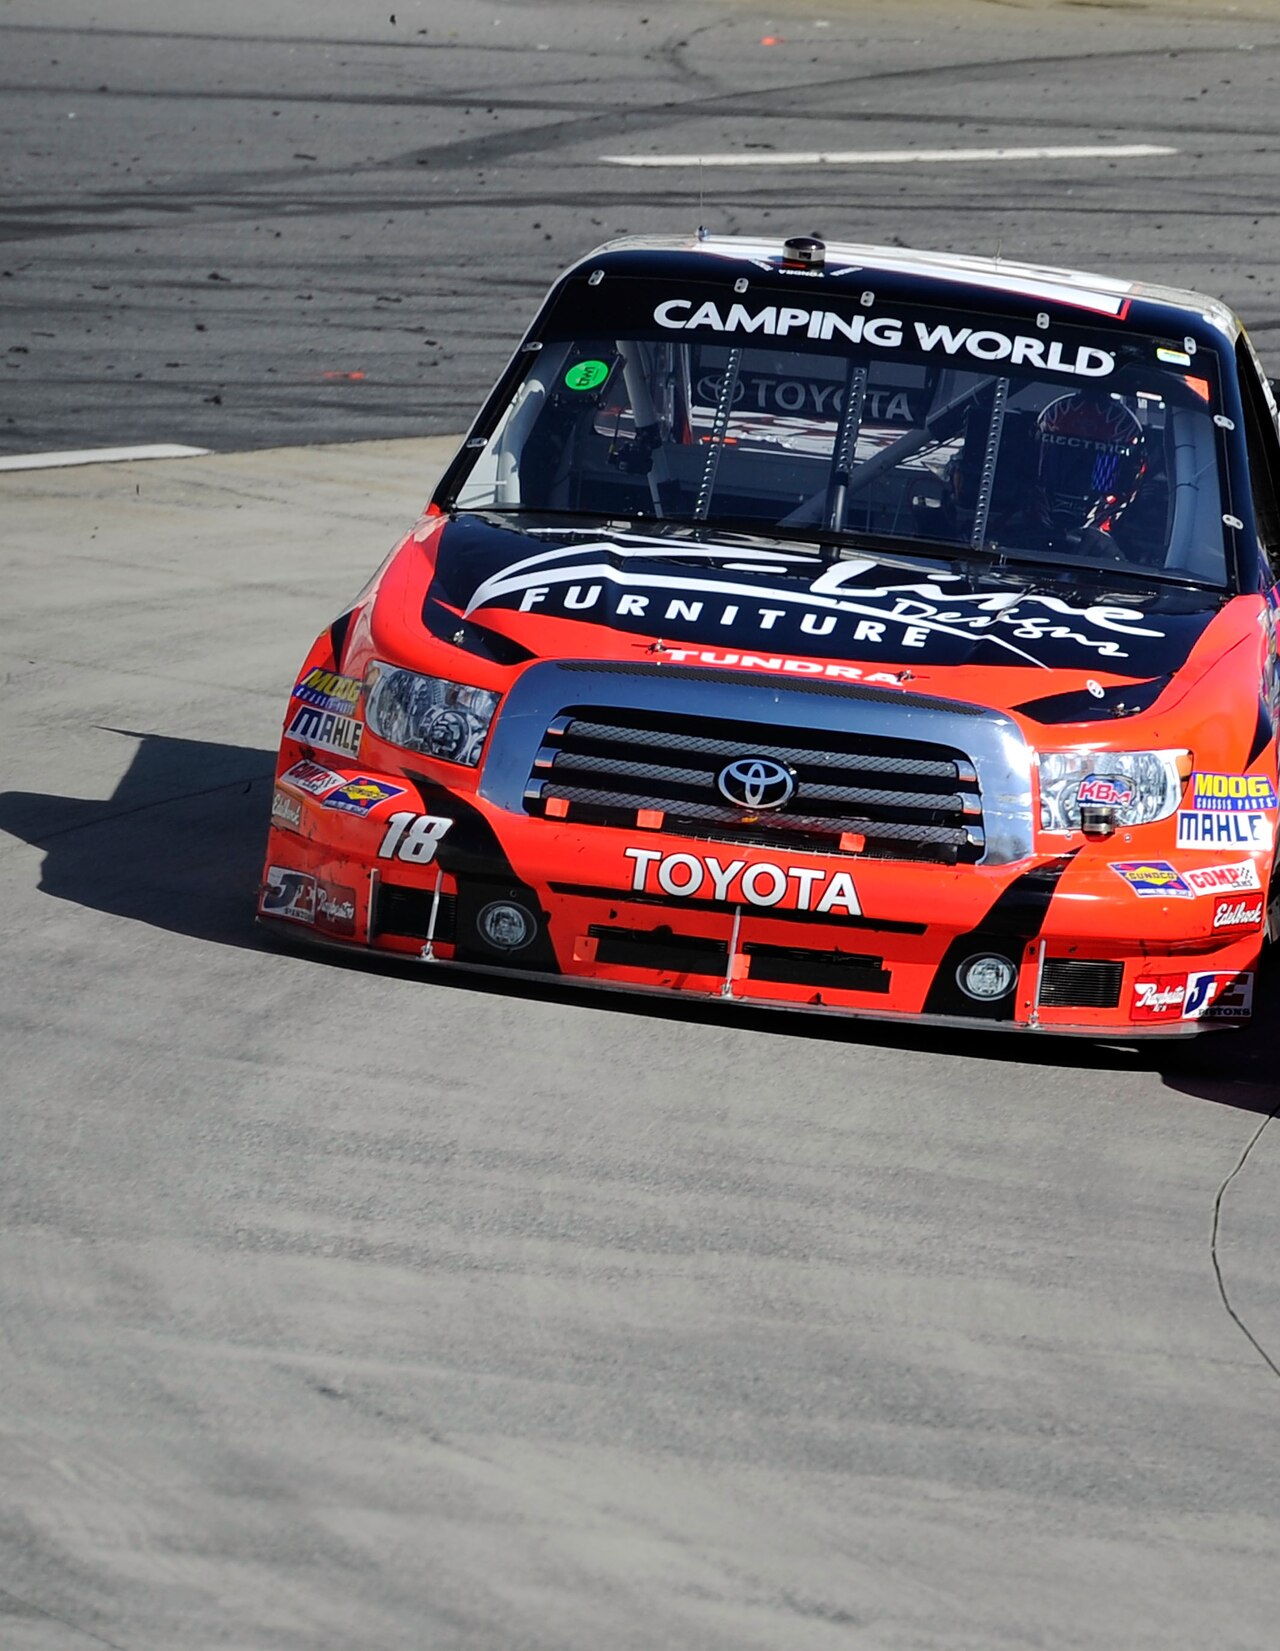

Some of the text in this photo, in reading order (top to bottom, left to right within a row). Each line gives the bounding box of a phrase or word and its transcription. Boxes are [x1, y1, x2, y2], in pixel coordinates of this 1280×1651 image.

[653, 299, 1116, 377] CAMPING WORLD
[518, 584, 931, 648] FURNITURE
[891, 597, 1129, 658] Designs
[662, 649, 904, 685] TUNDRA
[290, 706, 363, 755] MAHLE
[1077, 779, 1133, 806] KBM
[1194, 773, 1270, 798] MOOG
[378, 811, 455, 865] 18
[1179, 811, 1264, 842] MAHLE
[624, 847, 863, 917] TOYOTA
[1128, 871, 1179, 881] SUNOCO
[1188, 867, 1240, 890] COMP
[1212, 900, 1263, 929] Edelbrock
[1198, 1007, 1251, 1017] PISTONS
